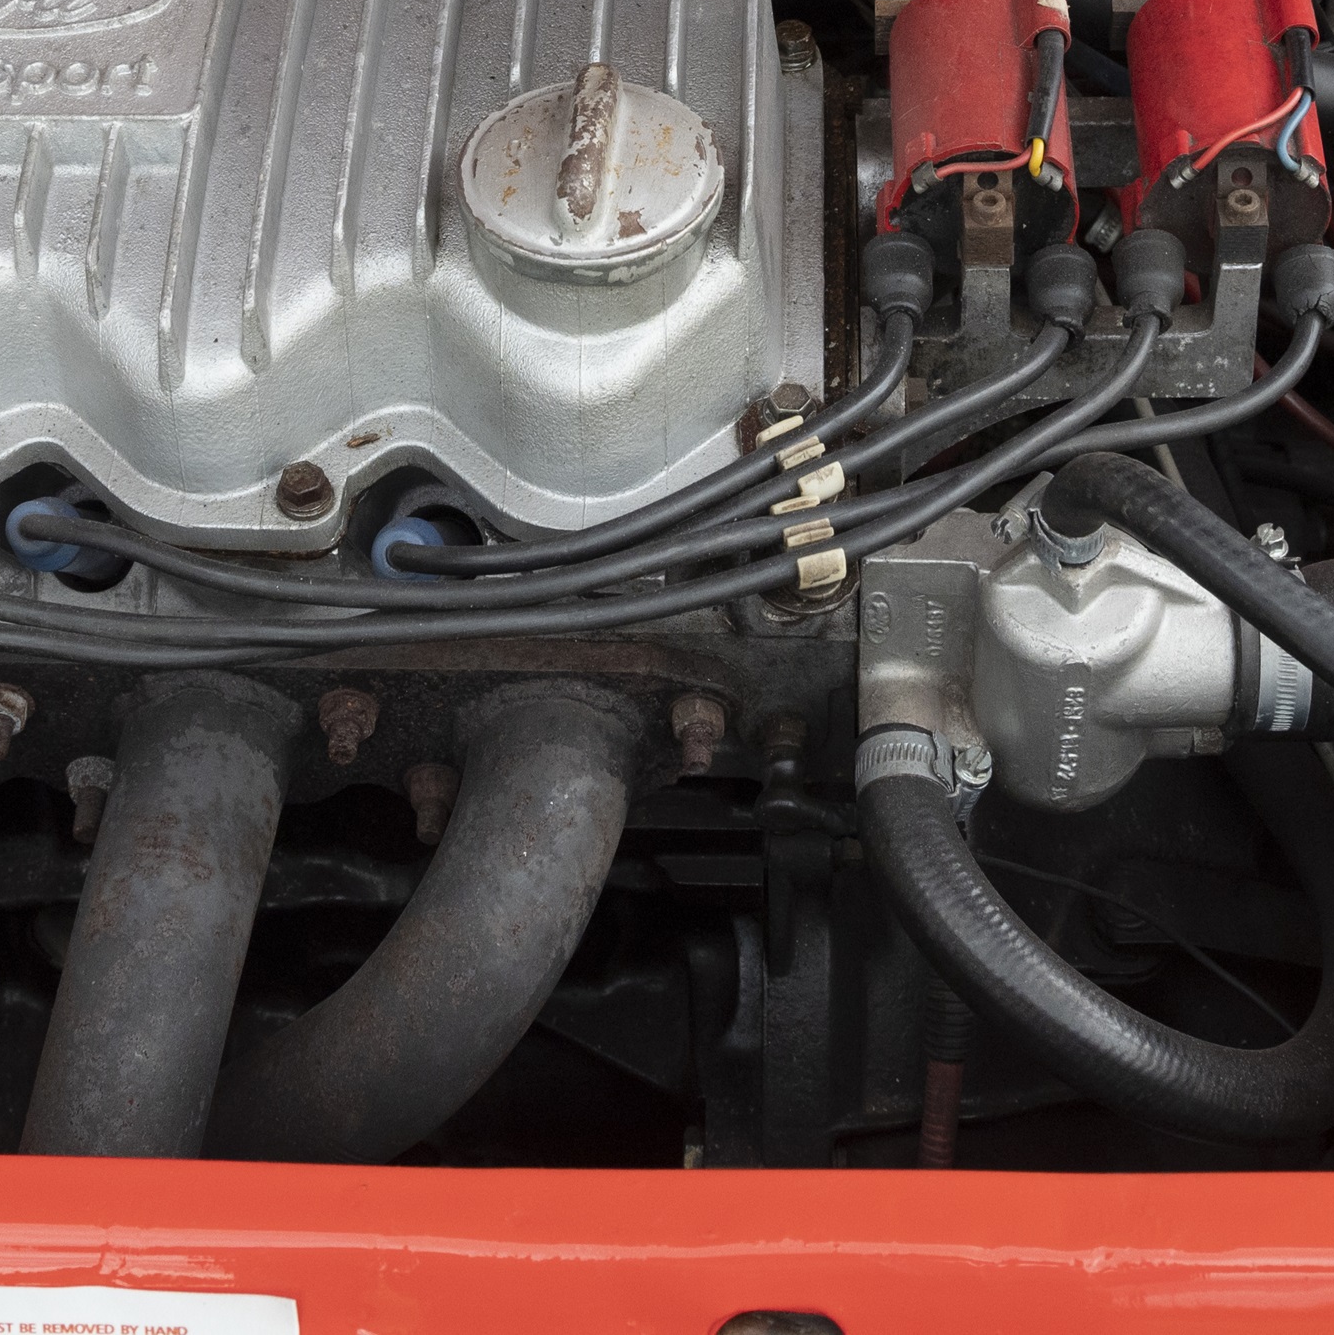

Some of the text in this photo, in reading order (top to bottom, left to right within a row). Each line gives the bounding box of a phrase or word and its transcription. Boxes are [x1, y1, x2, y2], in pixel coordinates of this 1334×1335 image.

[19, 1323, 37, 1334] BE
[43, 1323, 115, 1335] REMOVED
[120, 1324, 139, 1335] BY
[145, 1325, 188, 1335] HAND
